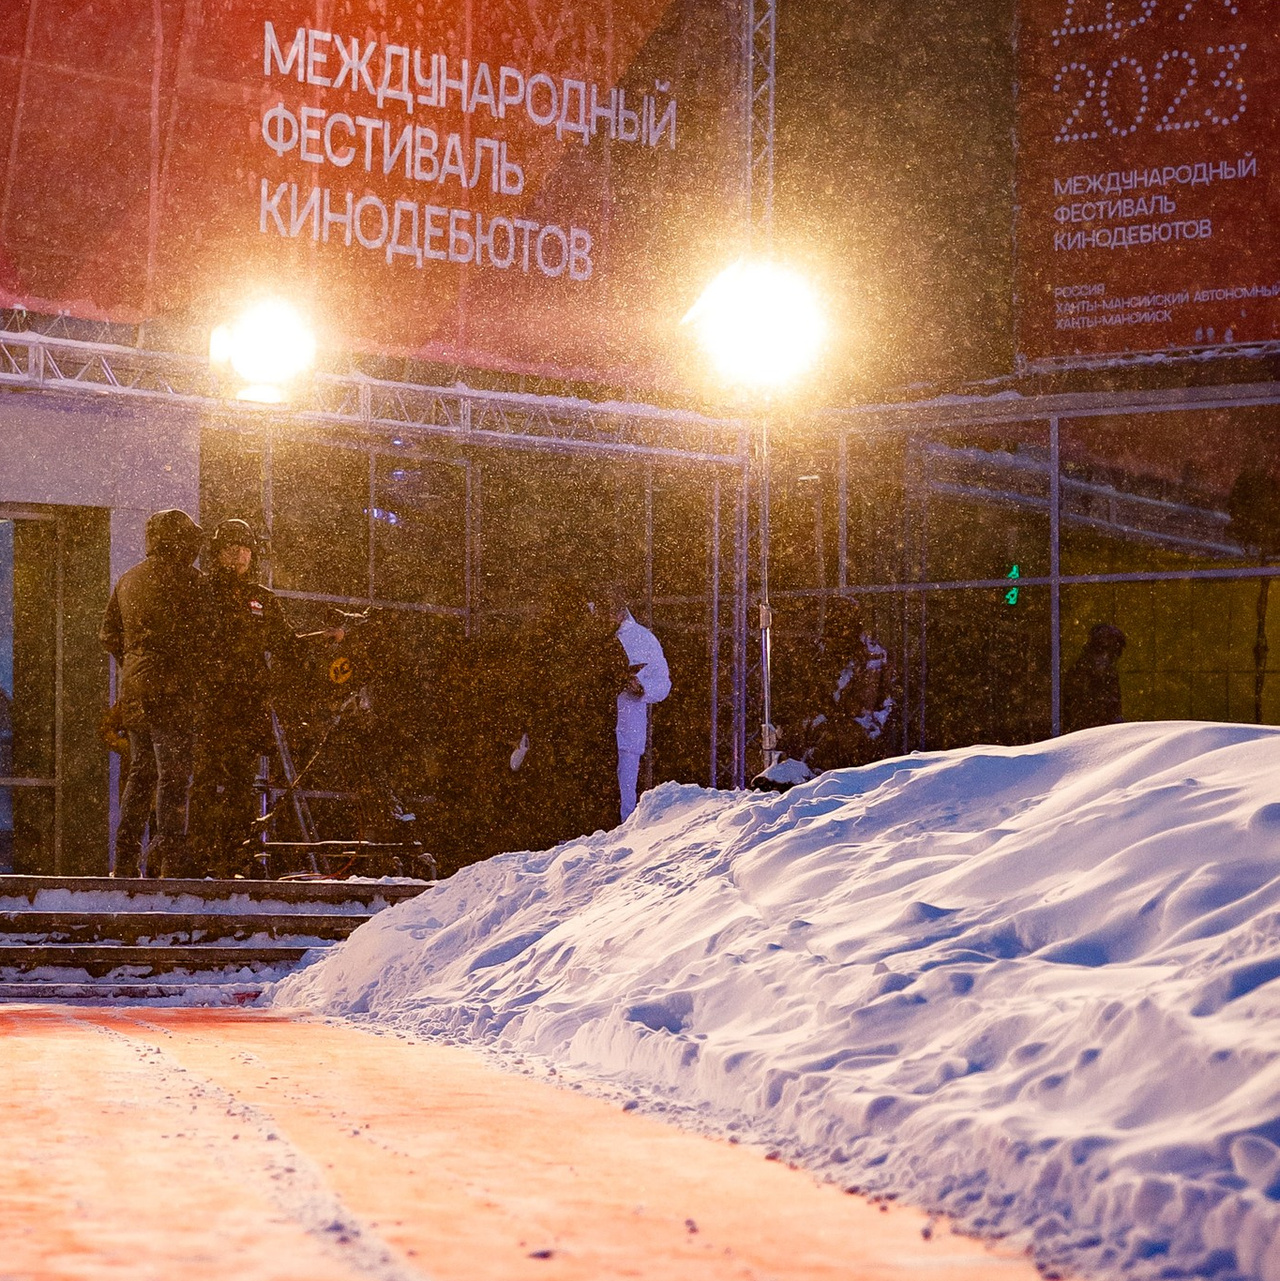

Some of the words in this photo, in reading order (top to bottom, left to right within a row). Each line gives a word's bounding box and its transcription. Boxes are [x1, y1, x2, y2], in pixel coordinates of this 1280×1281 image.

[263, 21, 678, 150] МЕЖДУНАРОДНЫЙ
[1051, 42, 1248, 143] 2023
[261, 102, 524, 196] ФЕСТИВАЛЬ
[1054, 151, 1258, 196] МЕЖДУНАРОДНЫЙ
[1053, 195, 1176, 224] ФЕСТИВАЛЬ
[259, 178, 593, 281] КИНОДЕБЮТОВ
[1053, 219, 1212, 251] КИНОДЕБЮТОВ
[1054, 283, 1105, 298] РОССИЯ
[1055, 288, 1190, 314] ХАНТЫ-МАНСИЙСКИЙ
[1055, 310, 1172, 330] ХАНТЫ-МАНСИЙСК
